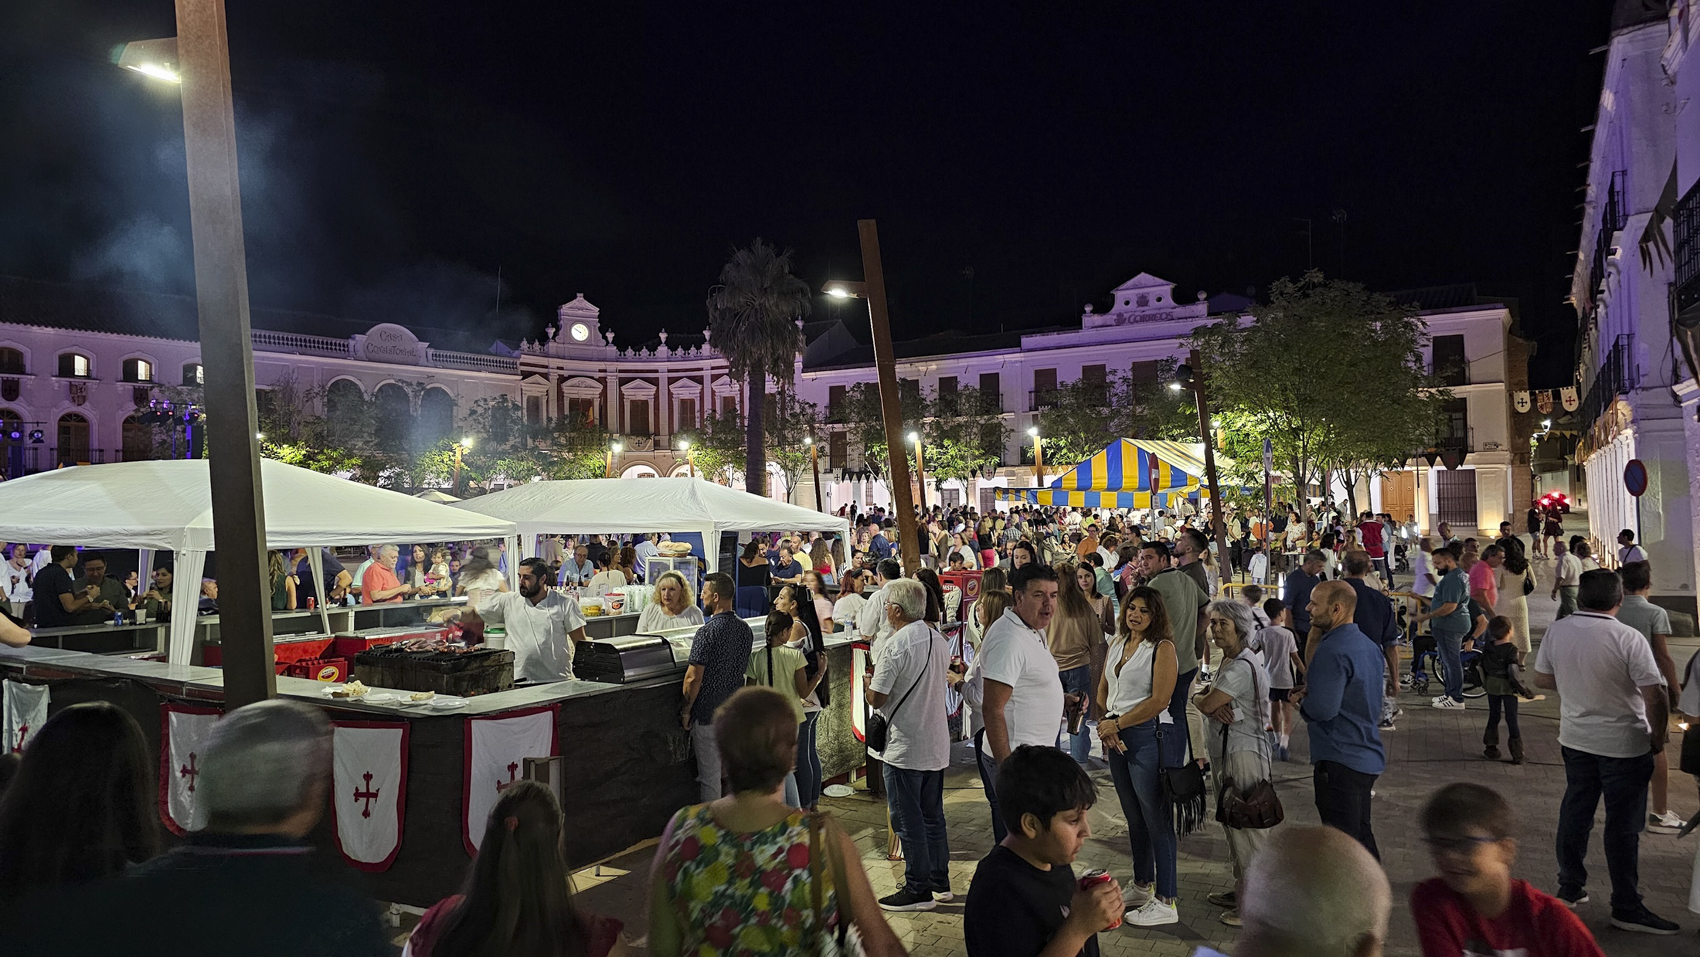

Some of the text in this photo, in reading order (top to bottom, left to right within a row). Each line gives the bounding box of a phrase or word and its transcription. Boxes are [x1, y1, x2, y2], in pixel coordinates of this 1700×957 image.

[1128, 312, 1174, 325] CORREOS
[380, 330, 403, 342] CASA
[367, 342, 417, 357] CONSISTORIAL
